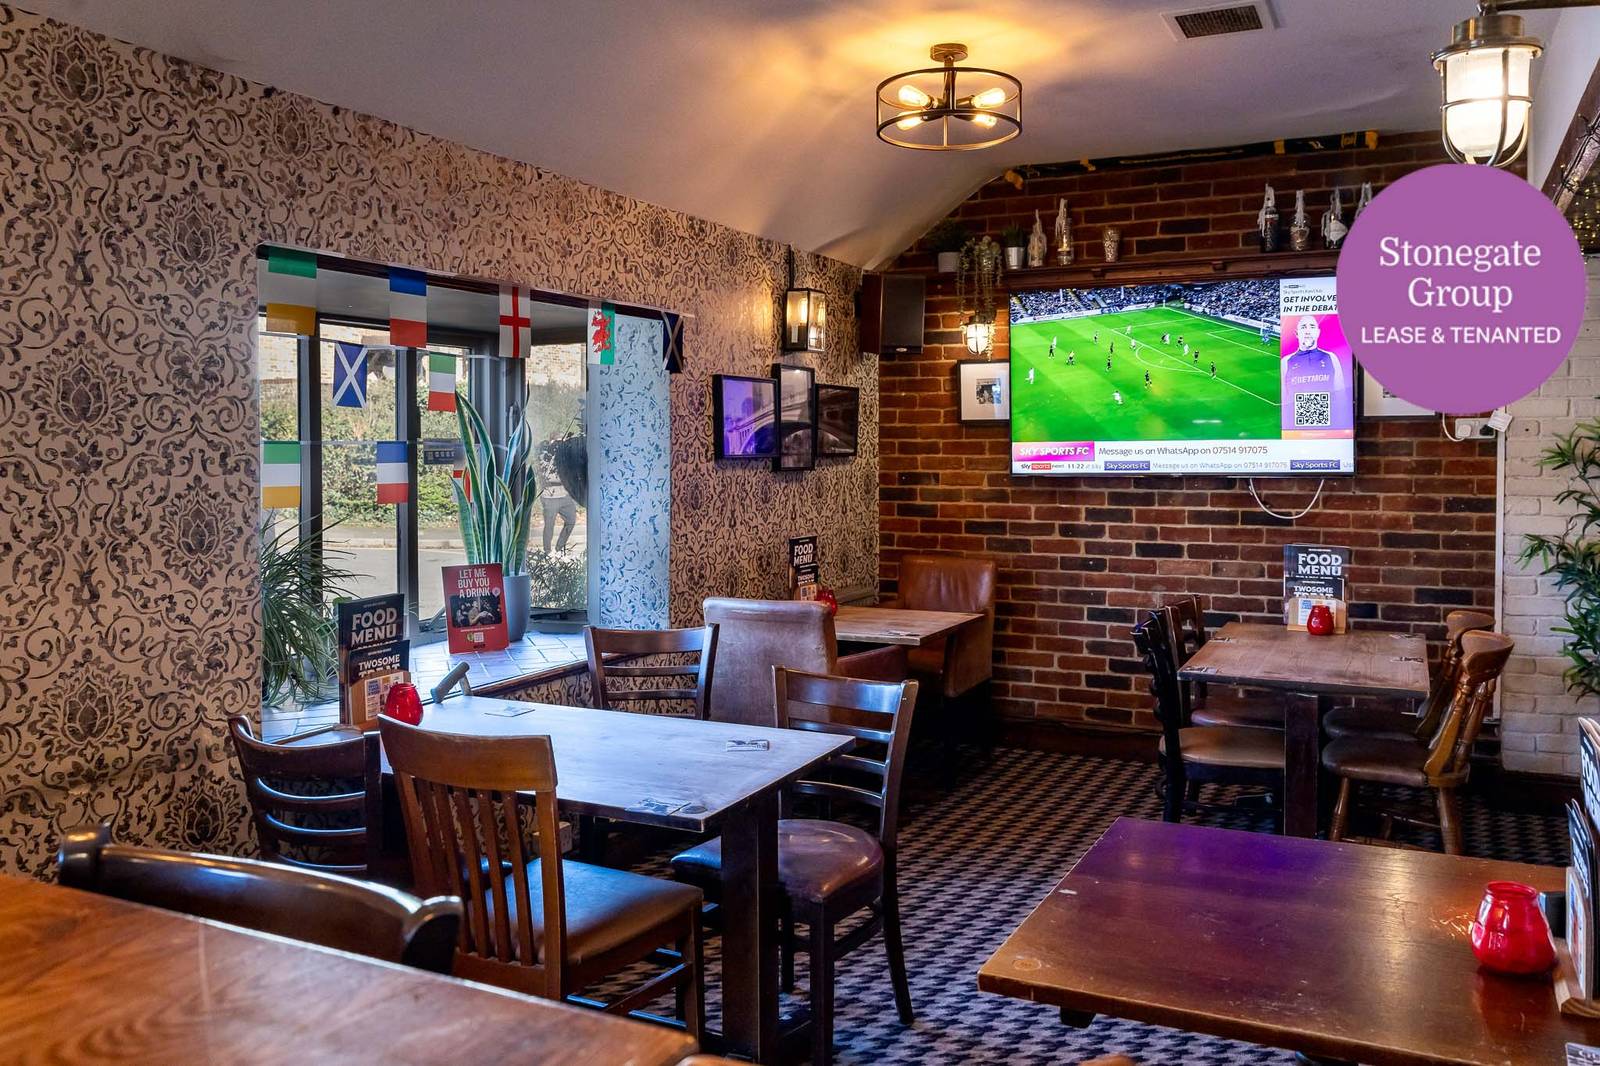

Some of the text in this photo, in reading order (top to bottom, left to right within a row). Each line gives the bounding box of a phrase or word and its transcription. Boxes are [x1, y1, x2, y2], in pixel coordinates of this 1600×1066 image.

[1311, 304, 1337, 312] DEBAT
[1020, 446, 1089, 456] SKY SPORTS FC
[1099, 447, 1133, 457] Message
[1156, 446, 1199, 456] WhatsApp
[1200, 447, 1211, 455] on
[1212, 446, 1237, 454] 07514
[1238, 446, 1268, 454] 917075
[1305, 461, 1328, 469] Sports
[1329, 461, 1339, 469] FC
[795, 543, 813, 555] FOOD
[794, 554, 812, 566] MENU
[1298, 553, 1342, 566] FOOD
[459, 567, 487, 579] LET ME
[1298, 565, 1342, 575] MENU
[458, 577, 490, 589] BUY YOU
[1294, 585, 1334, 593] TWOSOME
[459, 587, 491, 598] A DRINK
[352, 607, 397, 631] FOOD
[351, 623, 397, 648] MENU
[358, 654, 400, 671] TWOSOME
